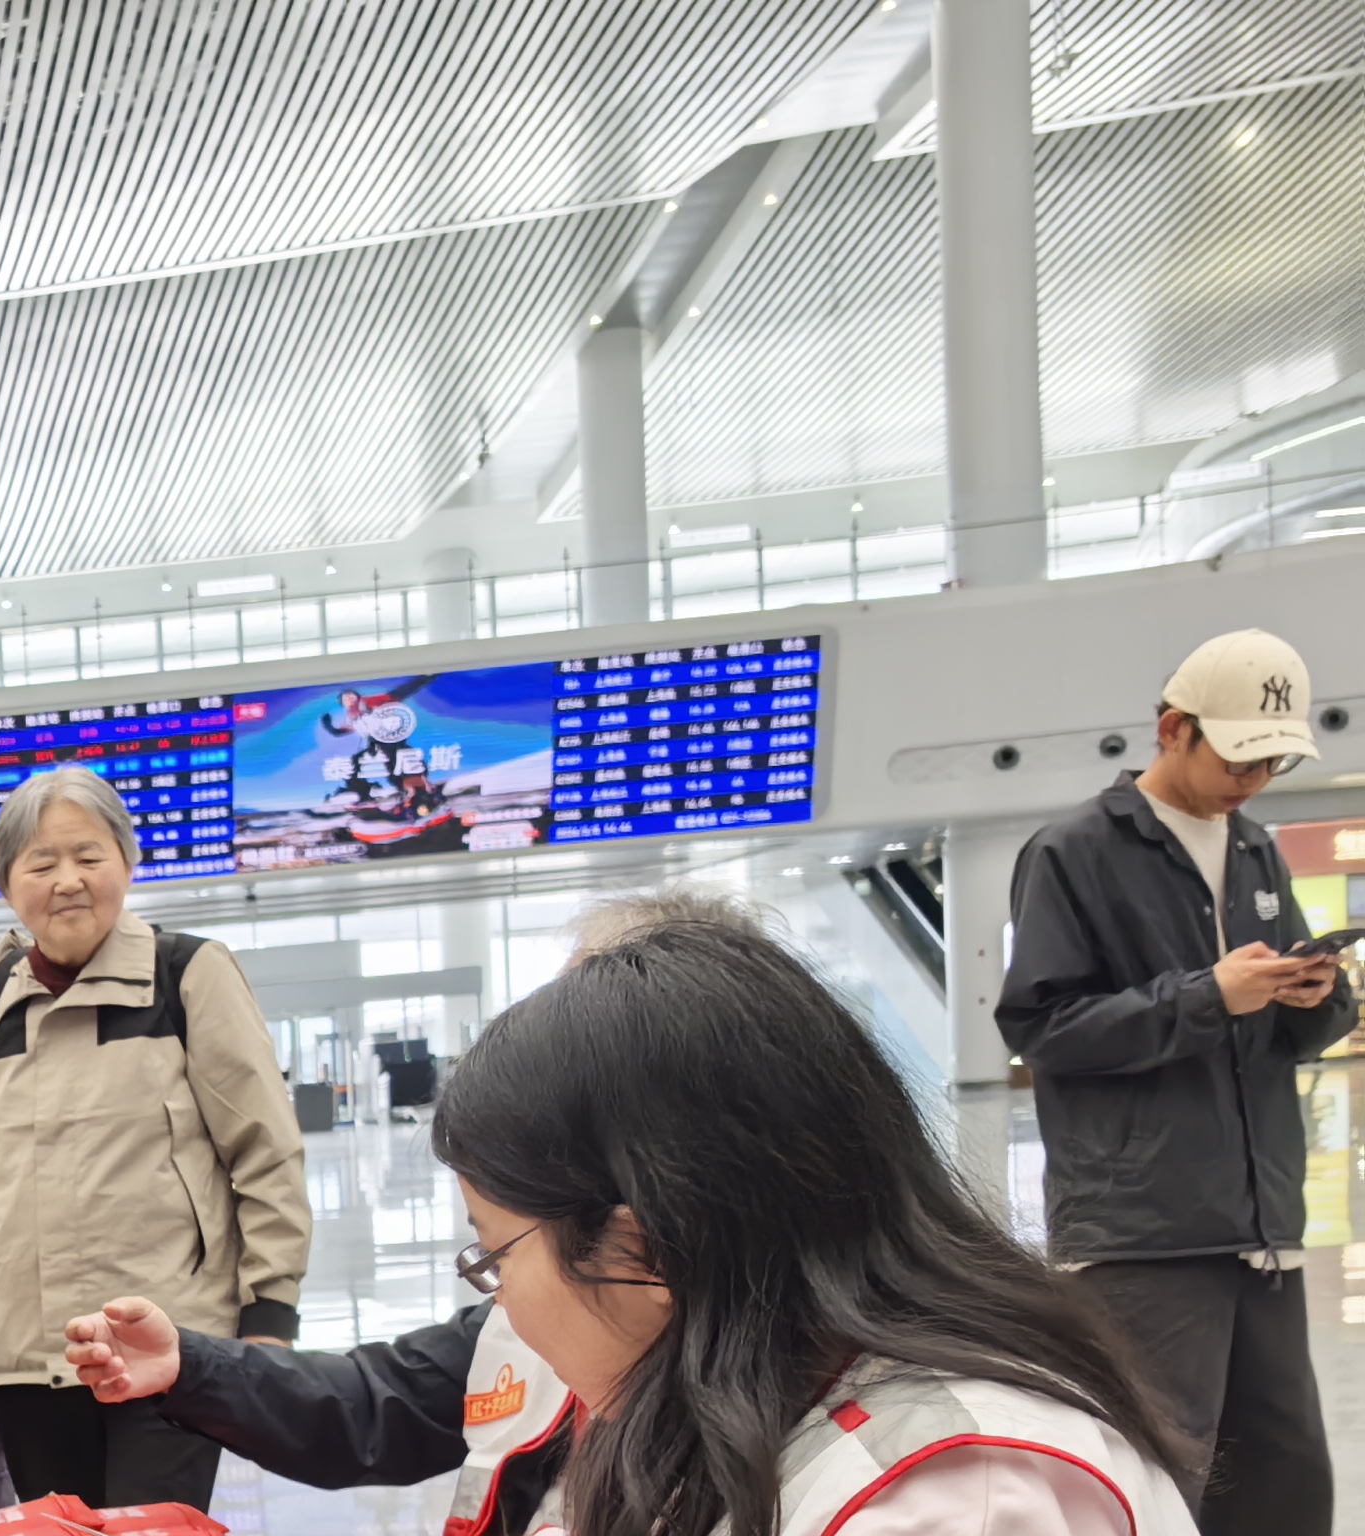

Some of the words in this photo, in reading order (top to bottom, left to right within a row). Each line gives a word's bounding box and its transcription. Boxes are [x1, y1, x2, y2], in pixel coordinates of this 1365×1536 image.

[1259, 674, 1292, 712] NY
[322, 743, 462, 781] 泰兰尼斯
